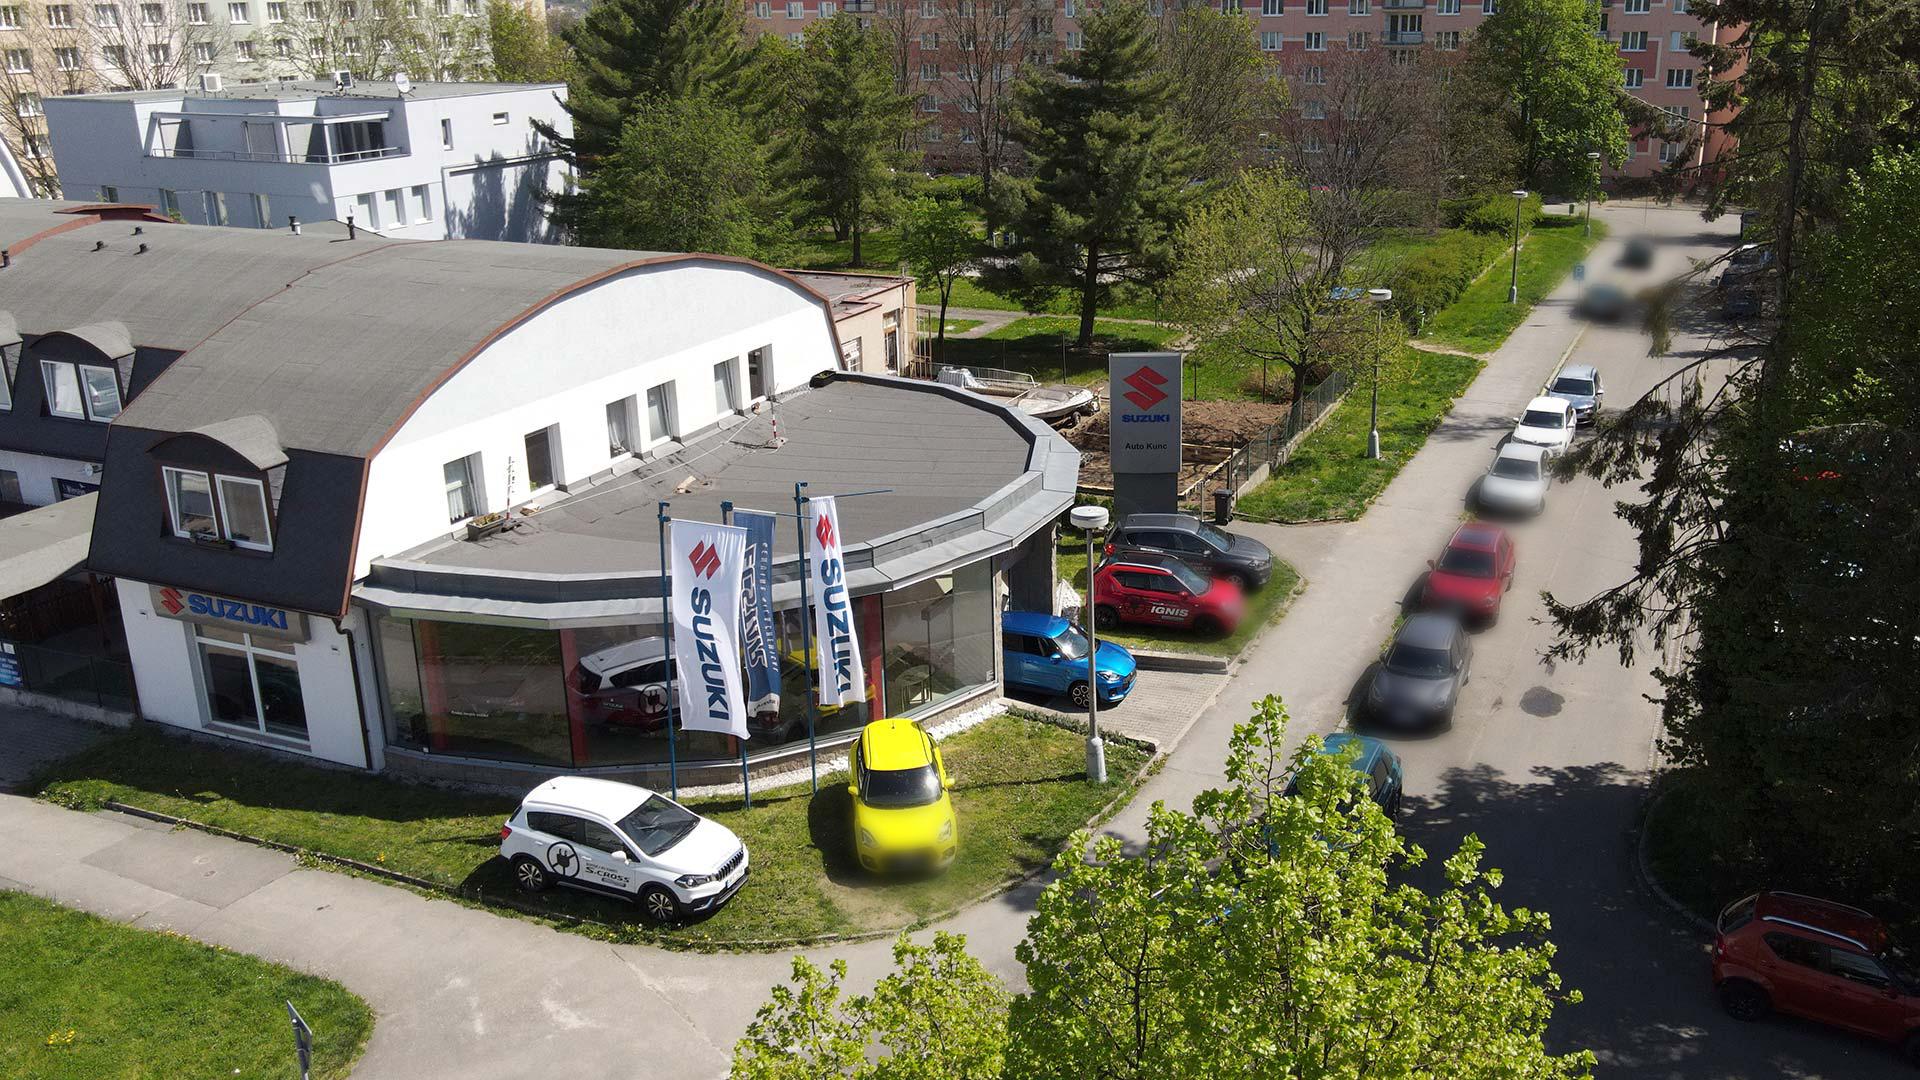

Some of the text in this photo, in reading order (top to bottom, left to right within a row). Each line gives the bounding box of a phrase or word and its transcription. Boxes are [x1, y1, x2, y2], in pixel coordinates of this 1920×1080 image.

[1122, 414, 1170, 423] SUZUKI
[1125, 442, 1144, 450] Auto
[187, 594, 288, 629] SUZUKI
[1150, 605, 1189, 617] IGNIS
[820, 558, 851, 696] SUZUKI
[691, 586, 730, 721] SUZUKI
